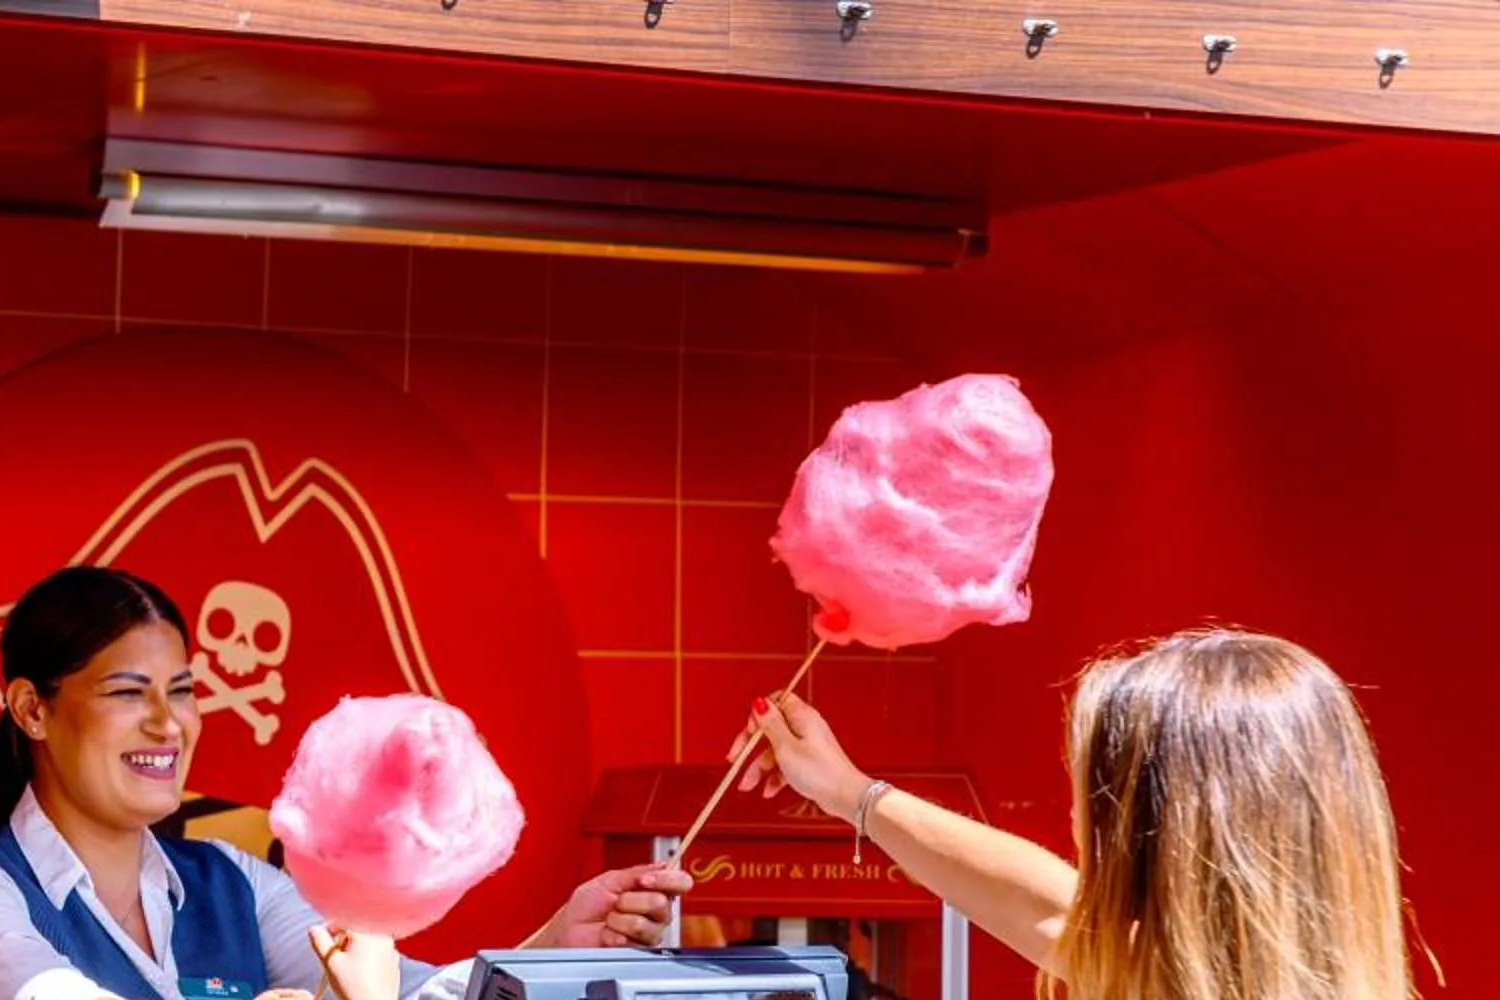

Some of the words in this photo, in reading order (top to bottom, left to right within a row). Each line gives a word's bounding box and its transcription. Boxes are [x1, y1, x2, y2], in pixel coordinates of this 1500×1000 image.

[740, 862, 785, 879] HOT
[789, 864, 805, 879] &
[811, 863, 880, 879] FRESH
